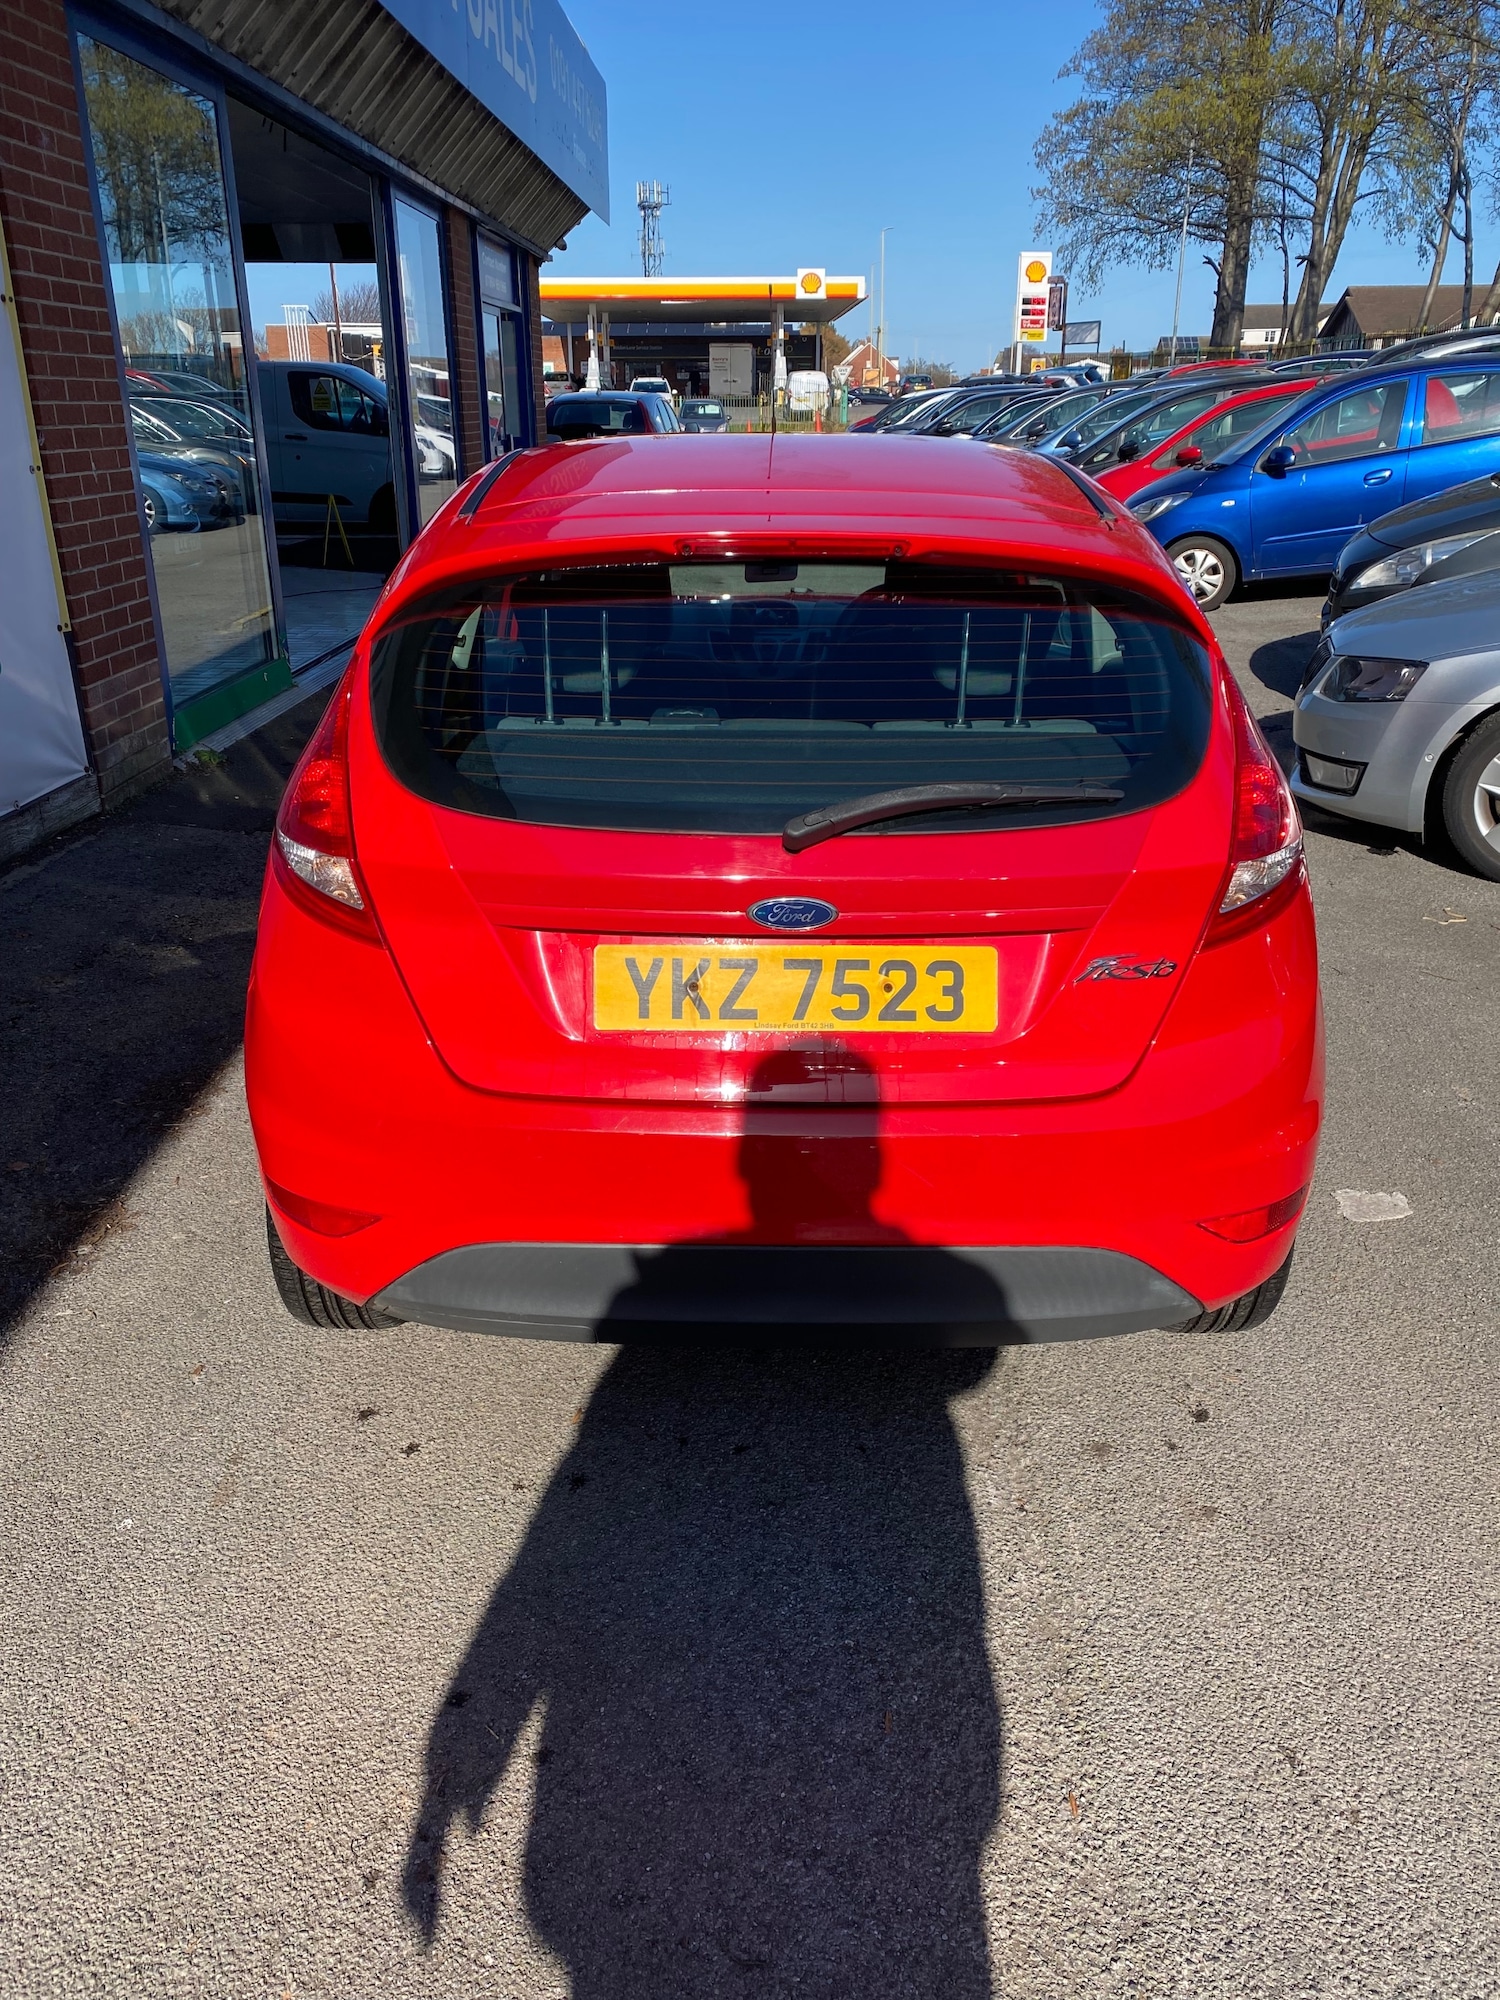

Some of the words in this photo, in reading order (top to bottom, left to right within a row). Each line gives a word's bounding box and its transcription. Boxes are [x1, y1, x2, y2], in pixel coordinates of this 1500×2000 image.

[768, 903, 816, 922] Ford
[625, 957, 759, 1020] YKZ
[783, 959, 965, 1022] 7523
[754, 1022, 780, 1030] Lindsay
